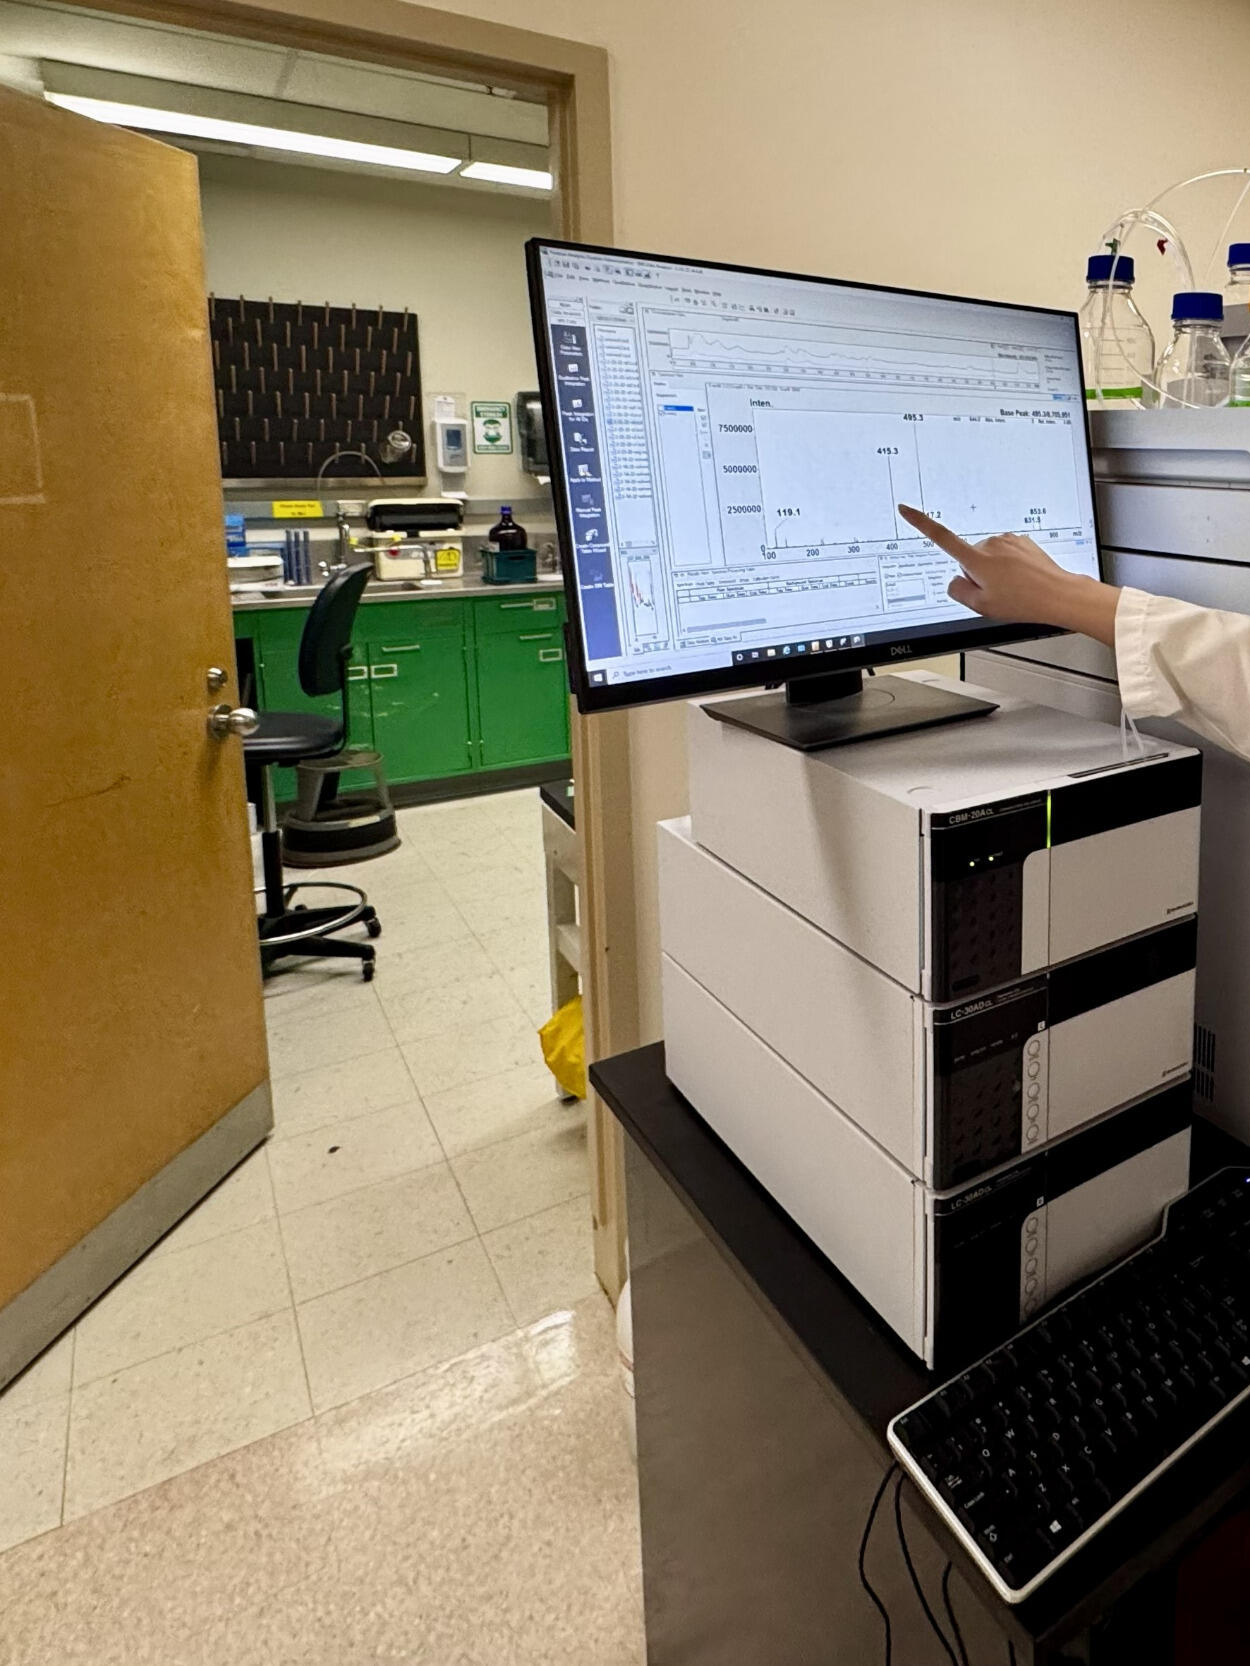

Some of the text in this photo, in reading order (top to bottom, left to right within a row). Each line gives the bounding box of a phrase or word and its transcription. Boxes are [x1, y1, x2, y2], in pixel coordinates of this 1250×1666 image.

[749, 398, 774, 408] Inten.
[719, 423, 753, 433] 7500000
[877, 447, 899, 455] 415.3
[723, 464, 757, 474] 5000000
[727, 504, 762, 514] 2500000
[776, 508, 801, 517] 119.1
[924, 511, 942, 519] 17.2
[806, 548, 820, 557] 200
[847, 545, 860, 554] 300
[886, 542, 899, 550] 400
[890, 644, 912, 656] DELL
